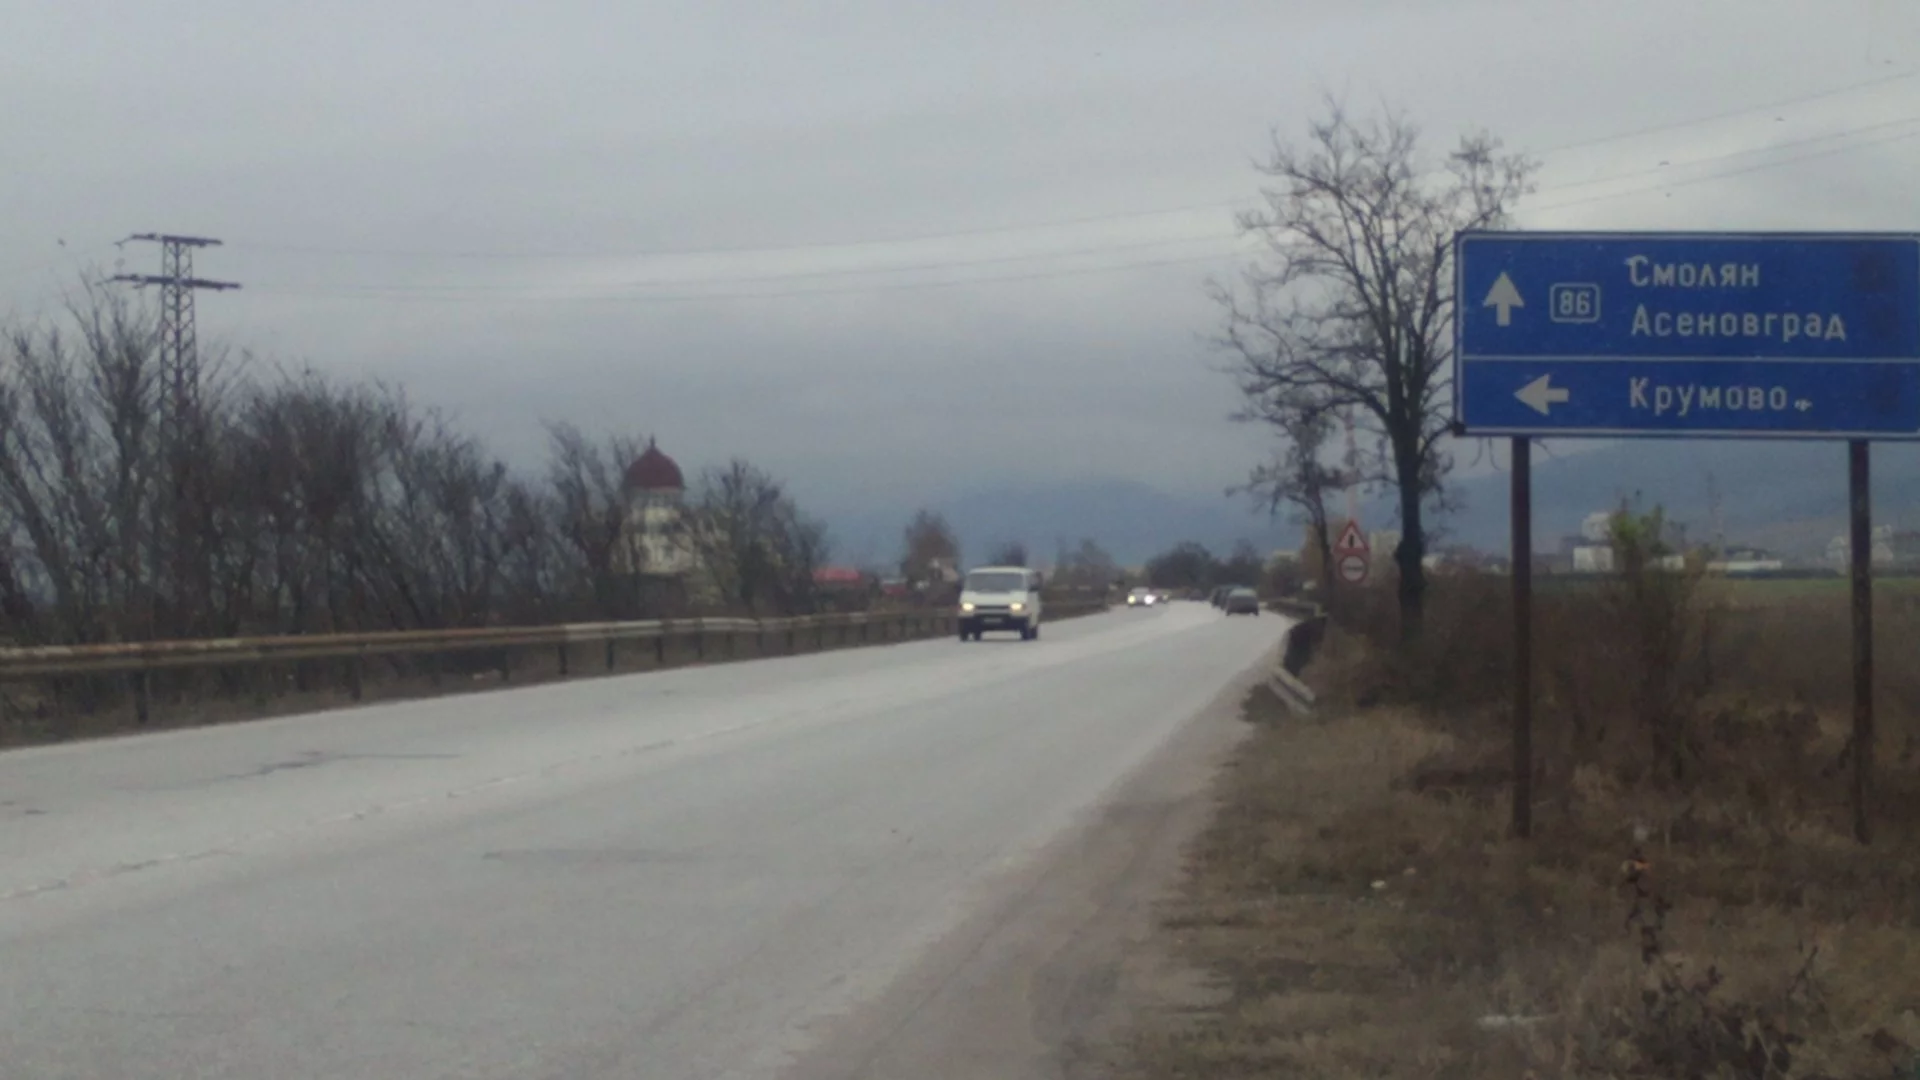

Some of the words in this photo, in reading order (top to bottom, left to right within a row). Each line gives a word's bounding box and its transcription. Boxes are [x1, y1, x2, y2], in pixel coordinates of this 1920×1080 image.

[1628, 255, 1760, 287] Смолян
[1560, 290, 1590, 315] 86
[1631, 303, 1846, 342] Асеновград
[1629, 377, 1788, 416] Крумово
